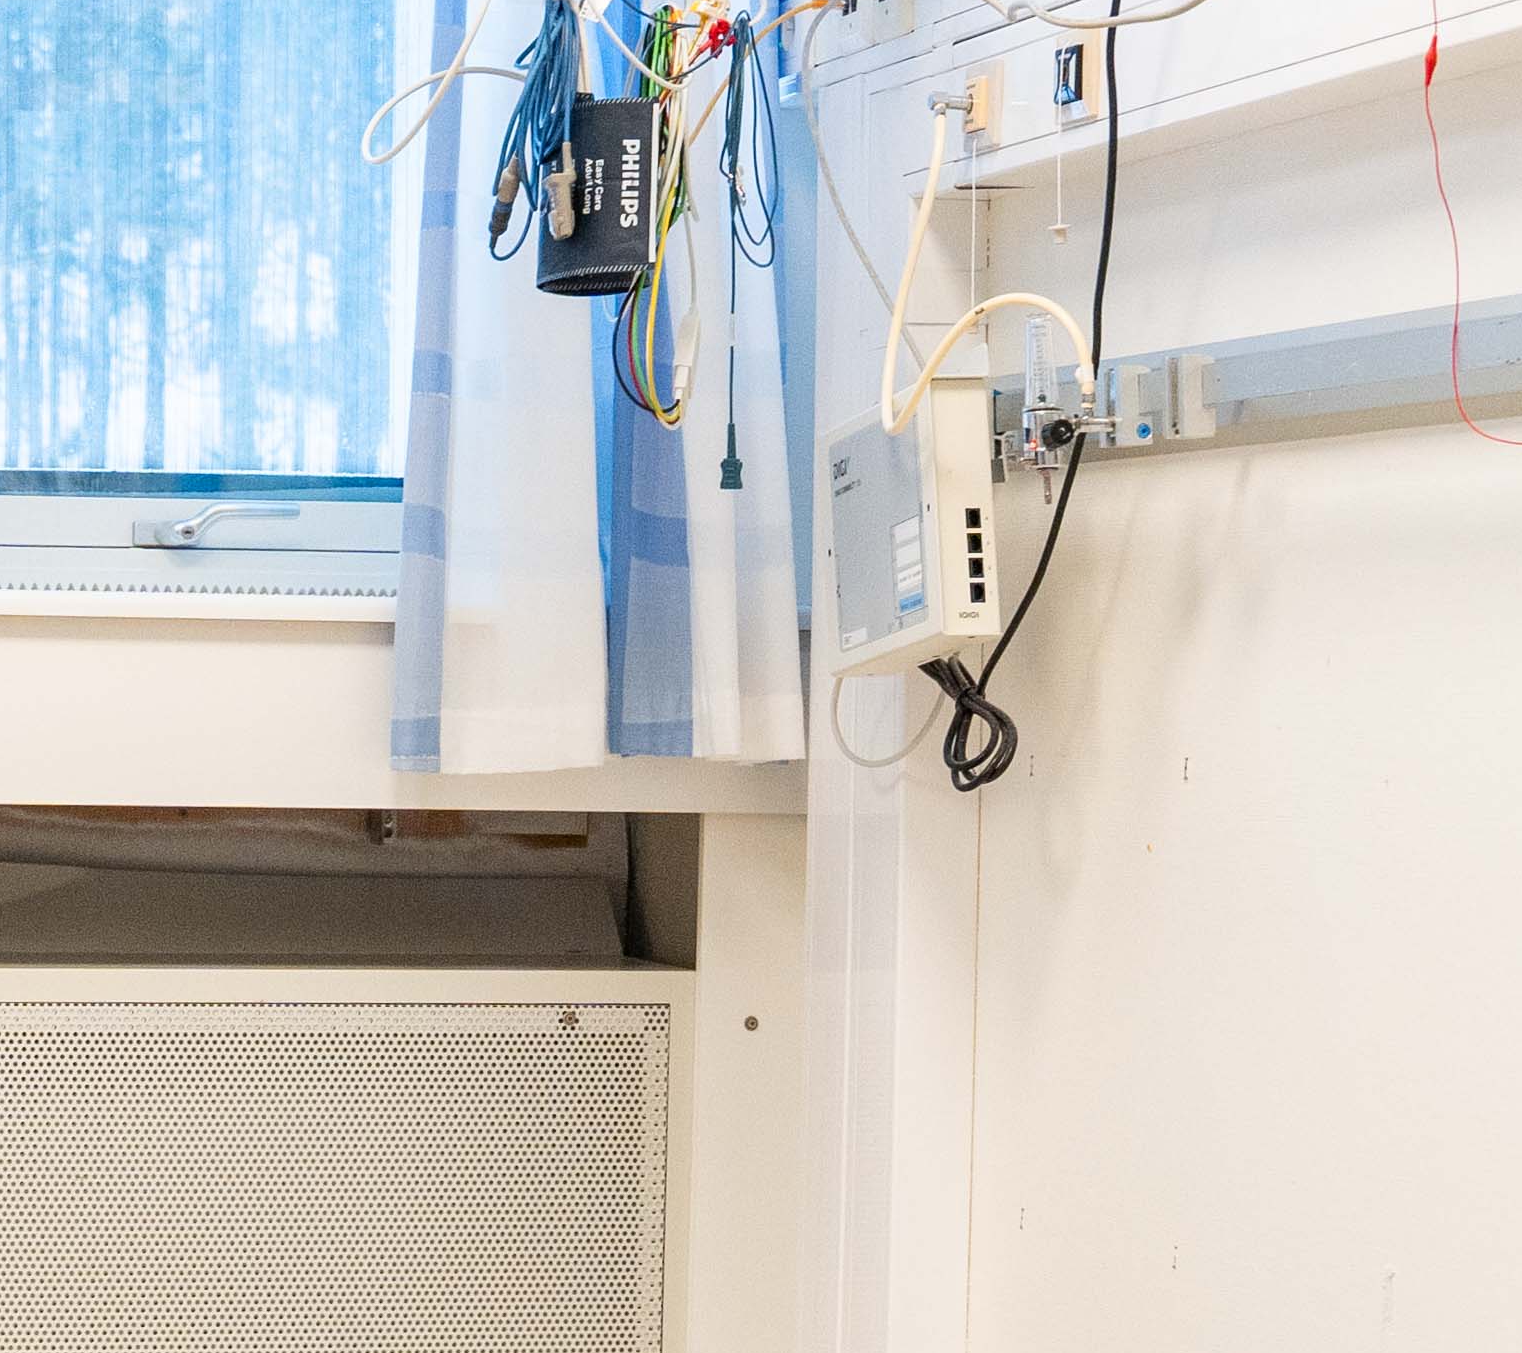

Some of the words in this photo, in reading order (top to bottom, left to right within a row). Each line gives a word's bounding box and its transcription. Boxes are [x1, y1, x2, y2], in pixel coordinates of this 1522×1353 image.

[585, 158, 594, 186] Adult
[595, 159, 605, 185] Easy
[620, 139, 641, 228] PHILIPS
[582, 188, 593, 215] Long
[593, 187, 604, 211] Care
